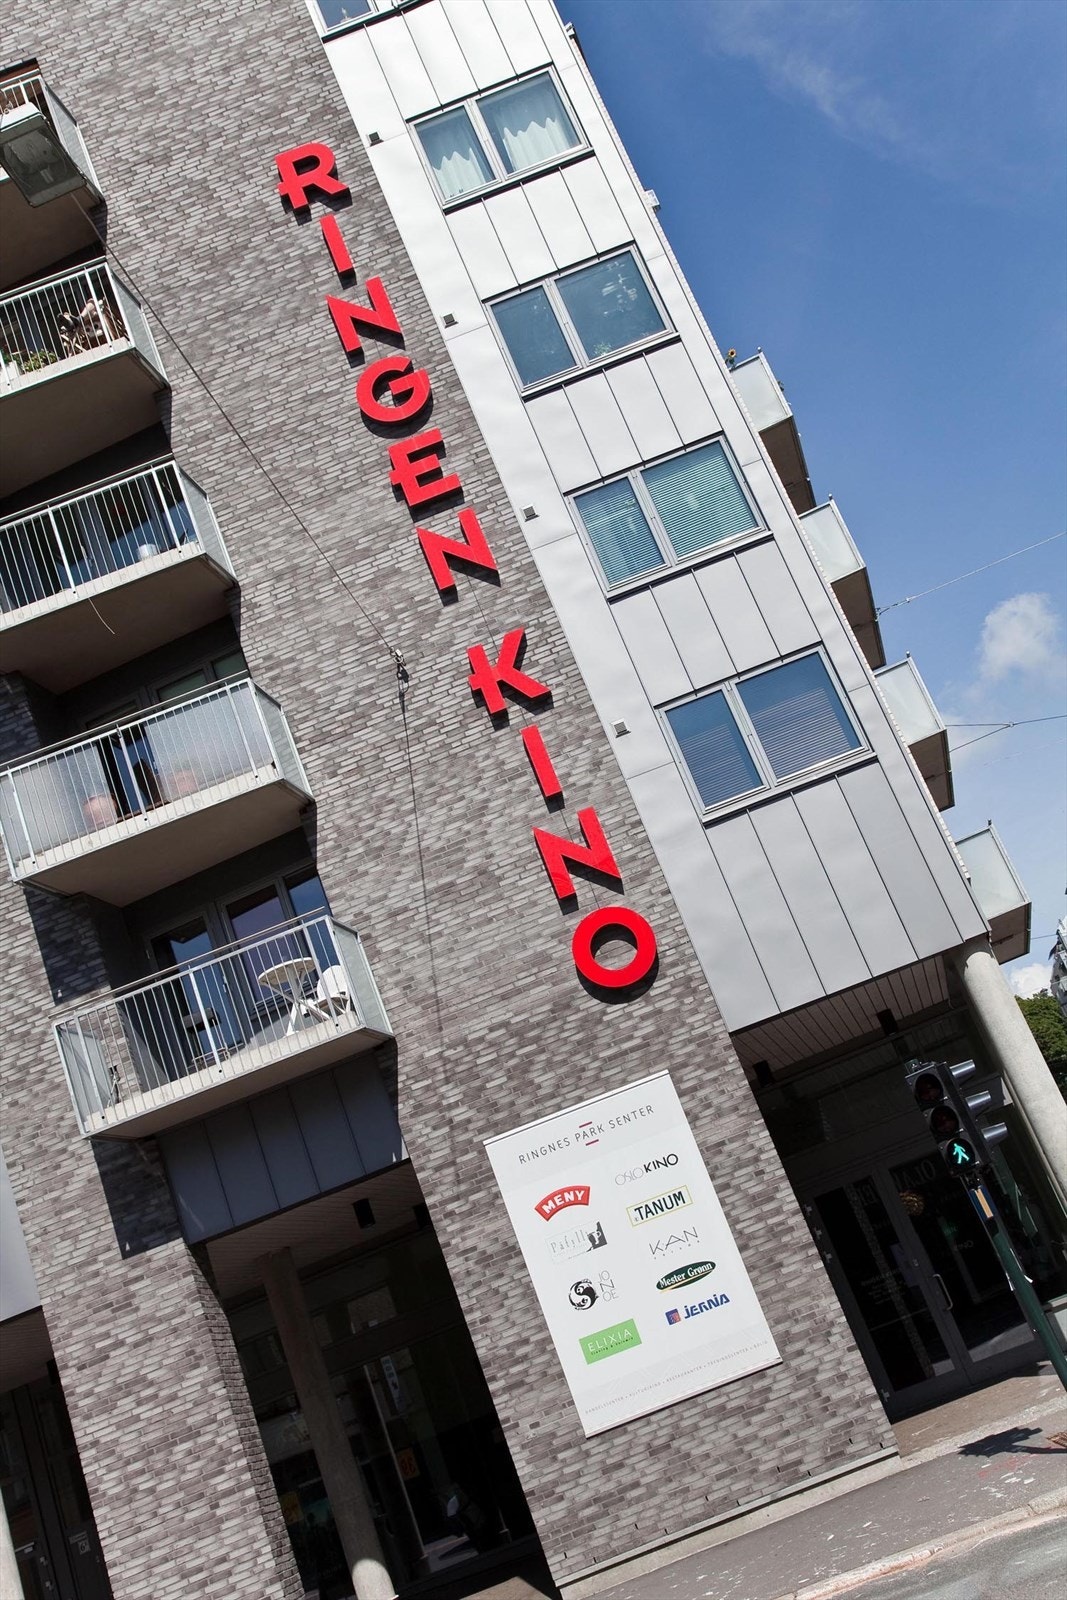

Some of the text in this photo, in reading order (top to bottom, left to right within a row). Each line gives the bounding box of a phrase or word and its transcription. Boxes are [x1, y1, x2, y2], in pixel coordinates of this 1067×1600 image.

[276, 142, 657, 988] RINGEN KINO
[518, 1104, 654, 1164] RINGNES PARK SENTER
[541, 1190, 585, 1214] MENY
[633, 1190, 686, 1221] TANUM
[649, 1226, 698, 1255] KAN
[660, 1272, 686, 1288] Mester
[587, 1328, 633, 1352] ELIXIA
